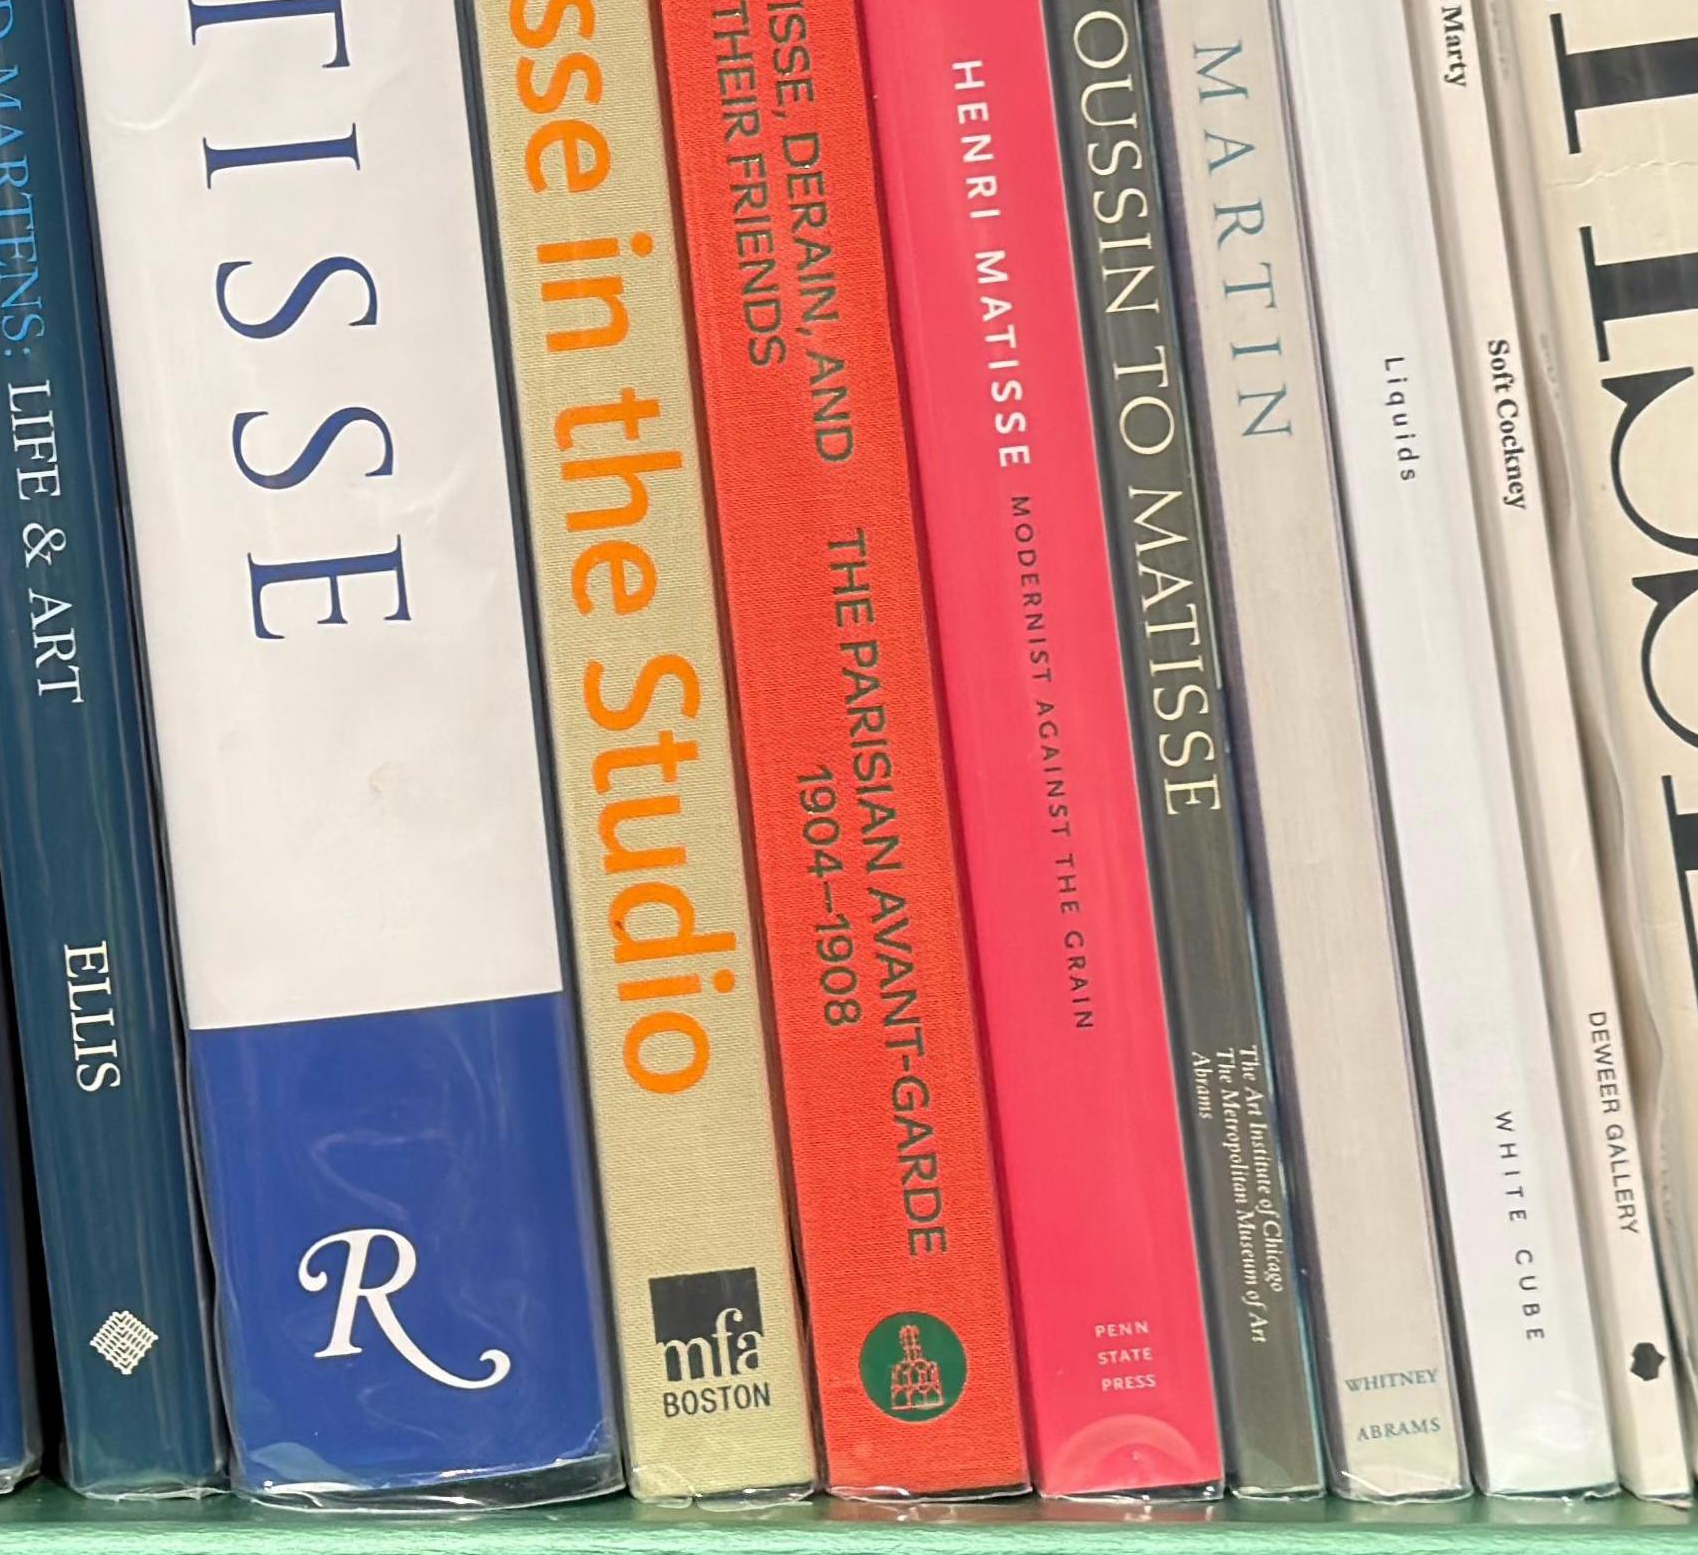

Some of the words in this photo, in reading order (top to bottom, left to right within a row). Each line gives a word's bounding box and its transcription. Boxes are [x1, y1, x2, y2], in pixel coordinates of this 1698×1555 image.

[1439, 6, 1468, 89] Marty
[952, 59, 1001, 221] HENRI
[728, 150, 788, 368] FRIENDS
[781, 131, 841, 339] DERAIN,
[1192, 38, 1294, 438] MARTIN
[535, 230, 653, 353] in
[805, 347, 855, 464] AND
[974, 248, 1033, 470] MATISSE
[1112, 345, 1176, 456] TO
[1486, 337, 1514, 394] Soft
[7, 379, 62, 502] LIFE
[1383, 354, 1417, 482] Liquids
[1493, 396, 1528, 511] Cockney
[22, 522, 67, 569] &
[553, 386, 683, 617] the
[826, 526, 876, 629] THE
[1010, 494, 1053, 684] MODERNIST
[28, 587, 85, 705] ART
[1127, 485, 1224, 816] MATISSE
[839, 640, 902, 876] PARISIAN
[1035, 699, 1072, 840] AGAINST
[583, 653, 738, 1094] Studio
[1055, 852, 1081, 915] THE
[63, 940, 122, 1093] ELLIS
[1063, 930, 1094, 1031] GRAIN
[866, 885, 949, 1257] AVANT-GARDE
[1191, 1050, 1214, 1121] Abrams
[1215, 1047, 1236, 1084] The
[1239, 1043, 1259, 1083] The
[1243, 1085, 1264, 1117] Art
[1588, 1010, 1622, 1115] DEWEER
[1221, 1087, 1249, 1205] Metropolitan
[1249, 1119, 1272, 1196] Institute
[1604, 1123, 1640, 1236] GALLERY
[1236, 1208, 1259, 1288] Museum
[1254, 1197, 1276, 1217] of
[1261, 1217, 1285, 1293] Chicago
[1494, 1109, 1528, 1222] WHITE
[1514, 1249, 1546, 1341] CUBE
[298, 1228, 511, 1390] R
[657, 1306, 765, 1382] mfa
[1094, 1320, 1150, 1339] PENN
[1240, 1289, 1262, 1308] of
[1248, 1308, 1268, 1345] Art
[663, 1382, 771, 1417] BOSTON
[1097, 1347, 1153, 1366] STATE
[1101, 1374, 1156, 1392] PRESS
[1344, 1367, 1439, 1393] WHITNEY
[1357, 1416, 1442, 1442] ABRAMS
